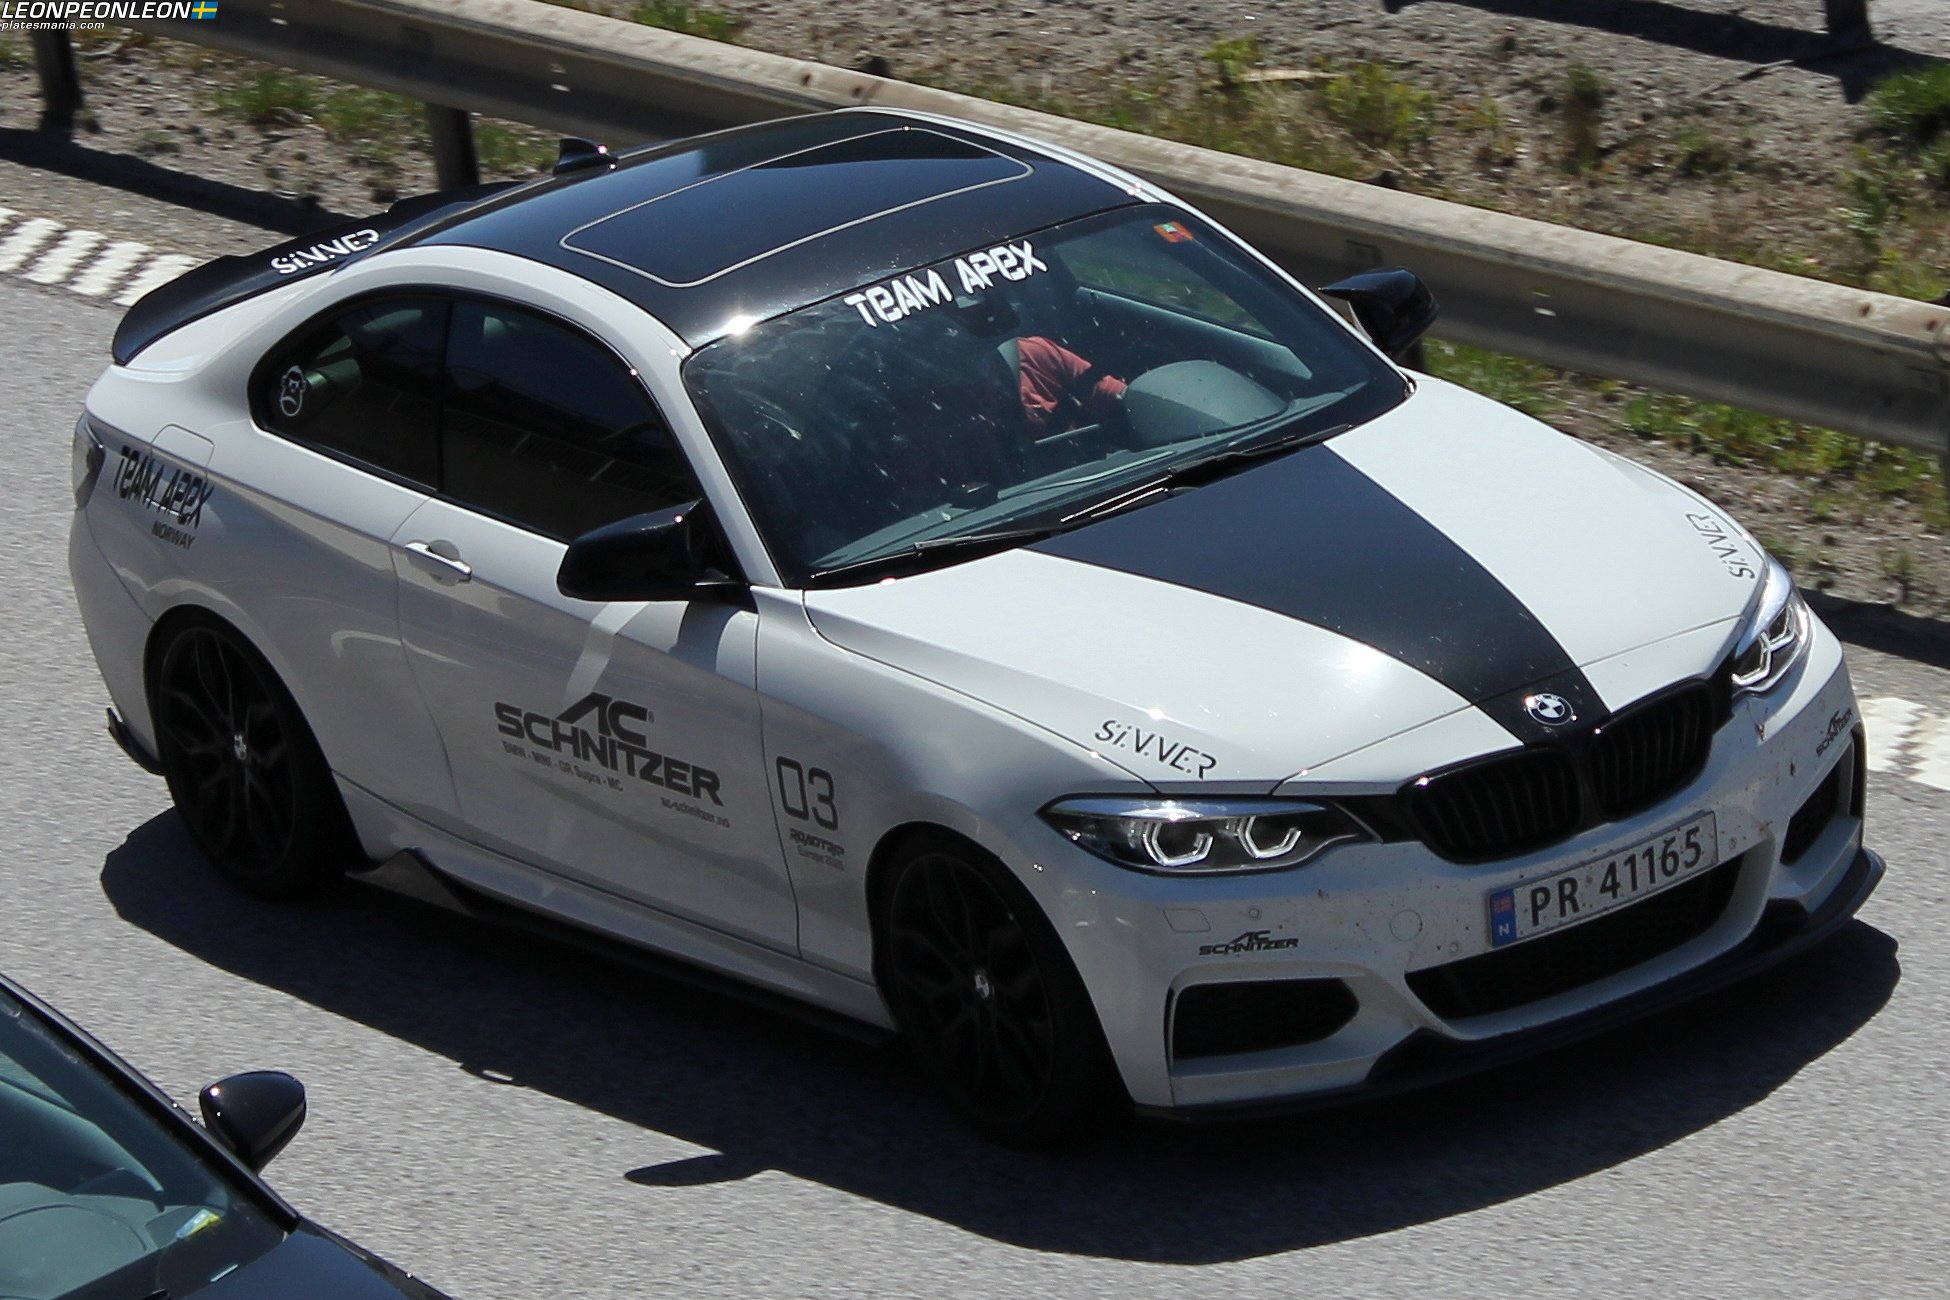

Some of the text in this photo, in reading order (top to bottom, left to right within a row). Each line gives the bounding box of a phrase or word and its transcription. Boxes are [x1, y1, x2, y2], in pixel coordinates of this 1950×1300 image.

[151, 520, 196, 550] NORWAY
[556, 692, 649, 748] AC
[494, 702, 724, 807] SCHNITZER
[776, 756, 838, 831] 03
[1530, 826, 1700, 926] PR 41165
[1198, 938, 1299, 955] SCHNITZER
[1499, 922, 1510, 936] N
